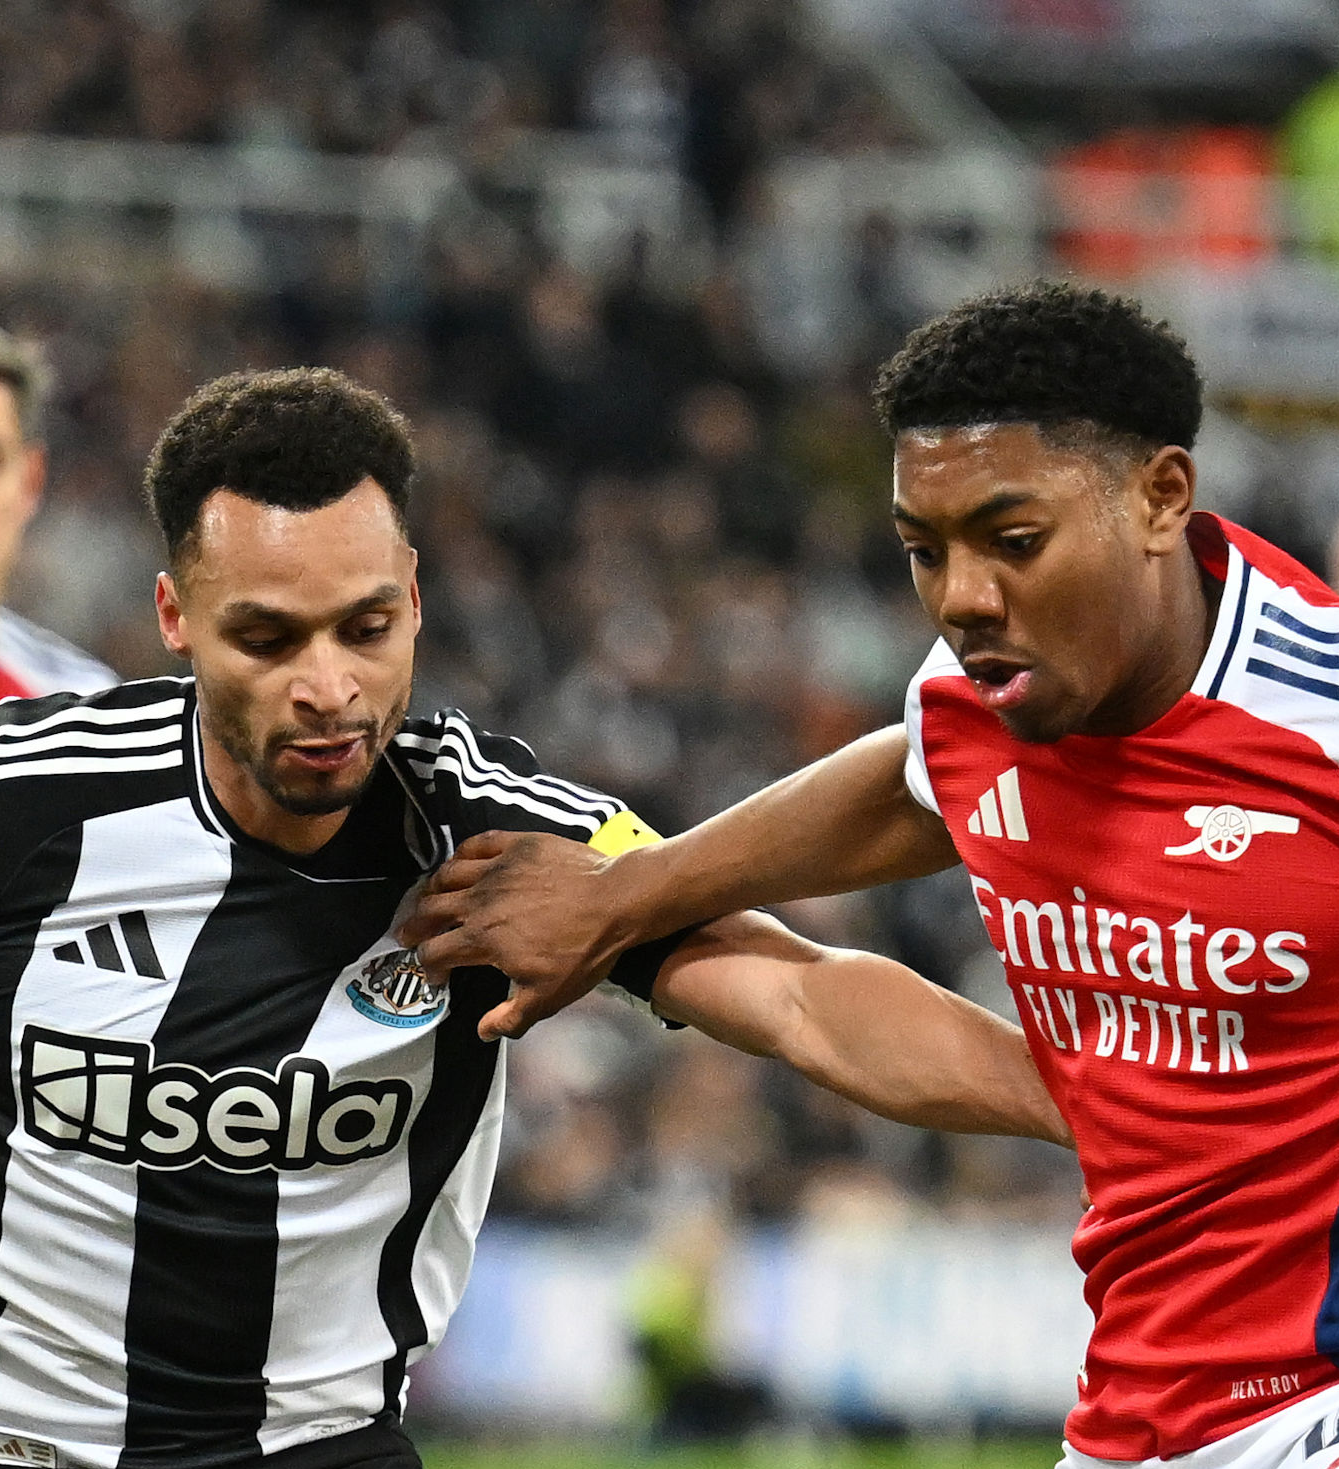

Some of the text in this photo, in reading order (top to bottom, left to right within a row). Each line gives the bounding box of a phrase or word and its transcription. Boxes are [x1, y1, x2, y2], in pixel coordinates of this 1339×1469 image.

[969, 873, 1310, 994] Emirates
[1022, 983, 1250, 1074] FLY BETTER
[140, 1070, 399, 1159] sela
